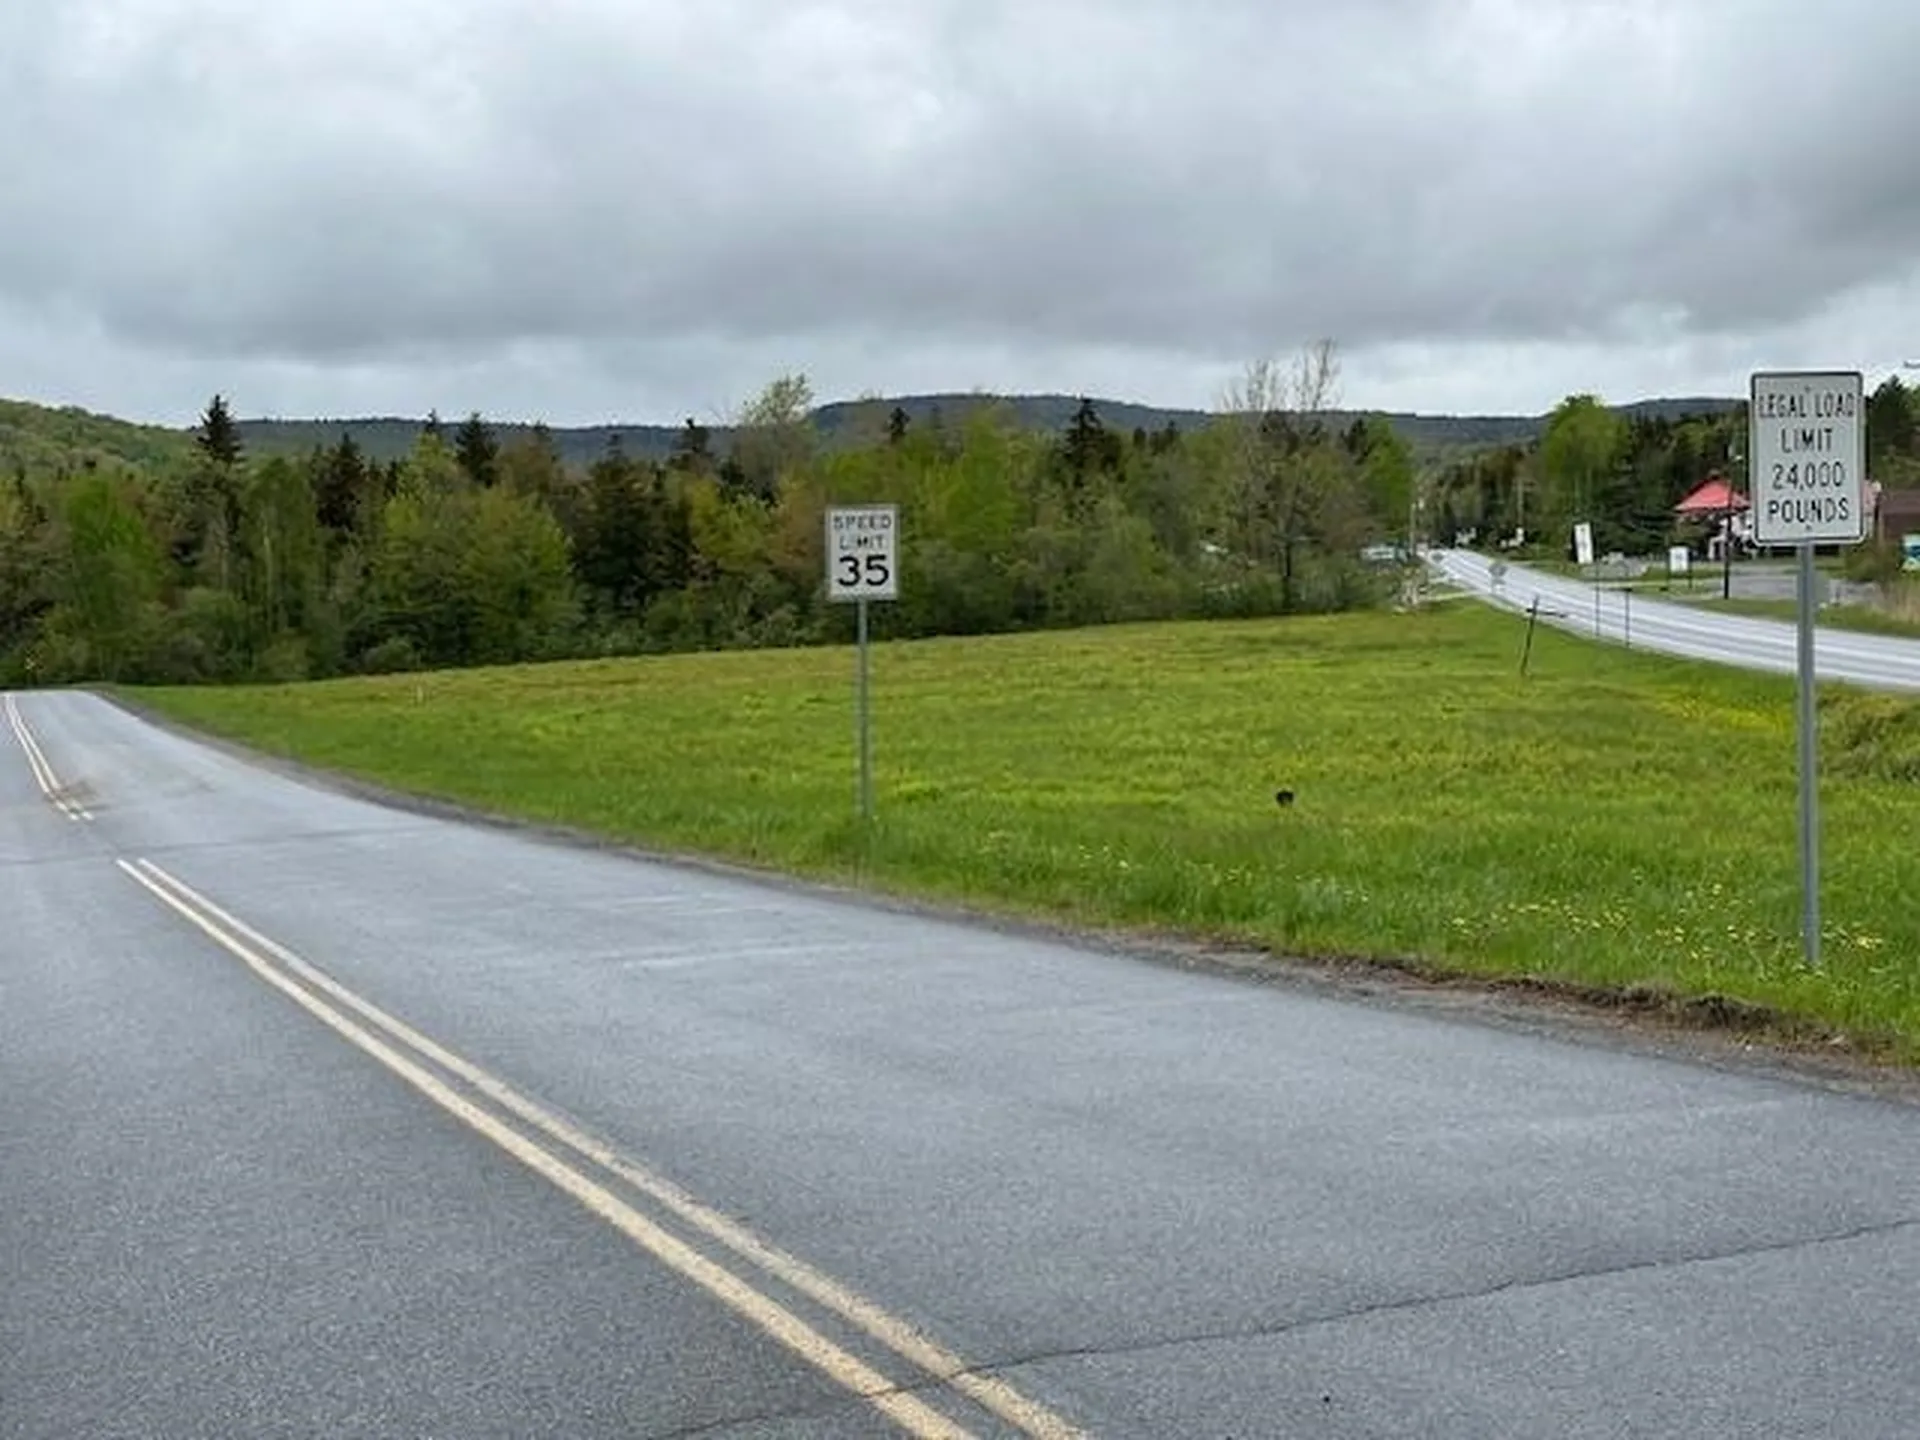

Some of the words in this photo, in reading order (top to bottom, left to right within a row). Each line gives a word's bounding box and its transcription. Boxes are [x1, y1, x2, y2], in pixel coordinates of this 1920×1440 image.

[1759, 393, 1807, 418] LEGAL
[1814, 392, 1855, 418] LOAD
[1781, 428, 1833, 453] LIMIT
[1772, 461, 1845, 491] 24,000
[833, 515, 892, 530] SPEED
[1767, 498, 1849, 523] POUNDS
[839, 534, 885, 550] LIMIT
[839, 555, 889, 586] 35
